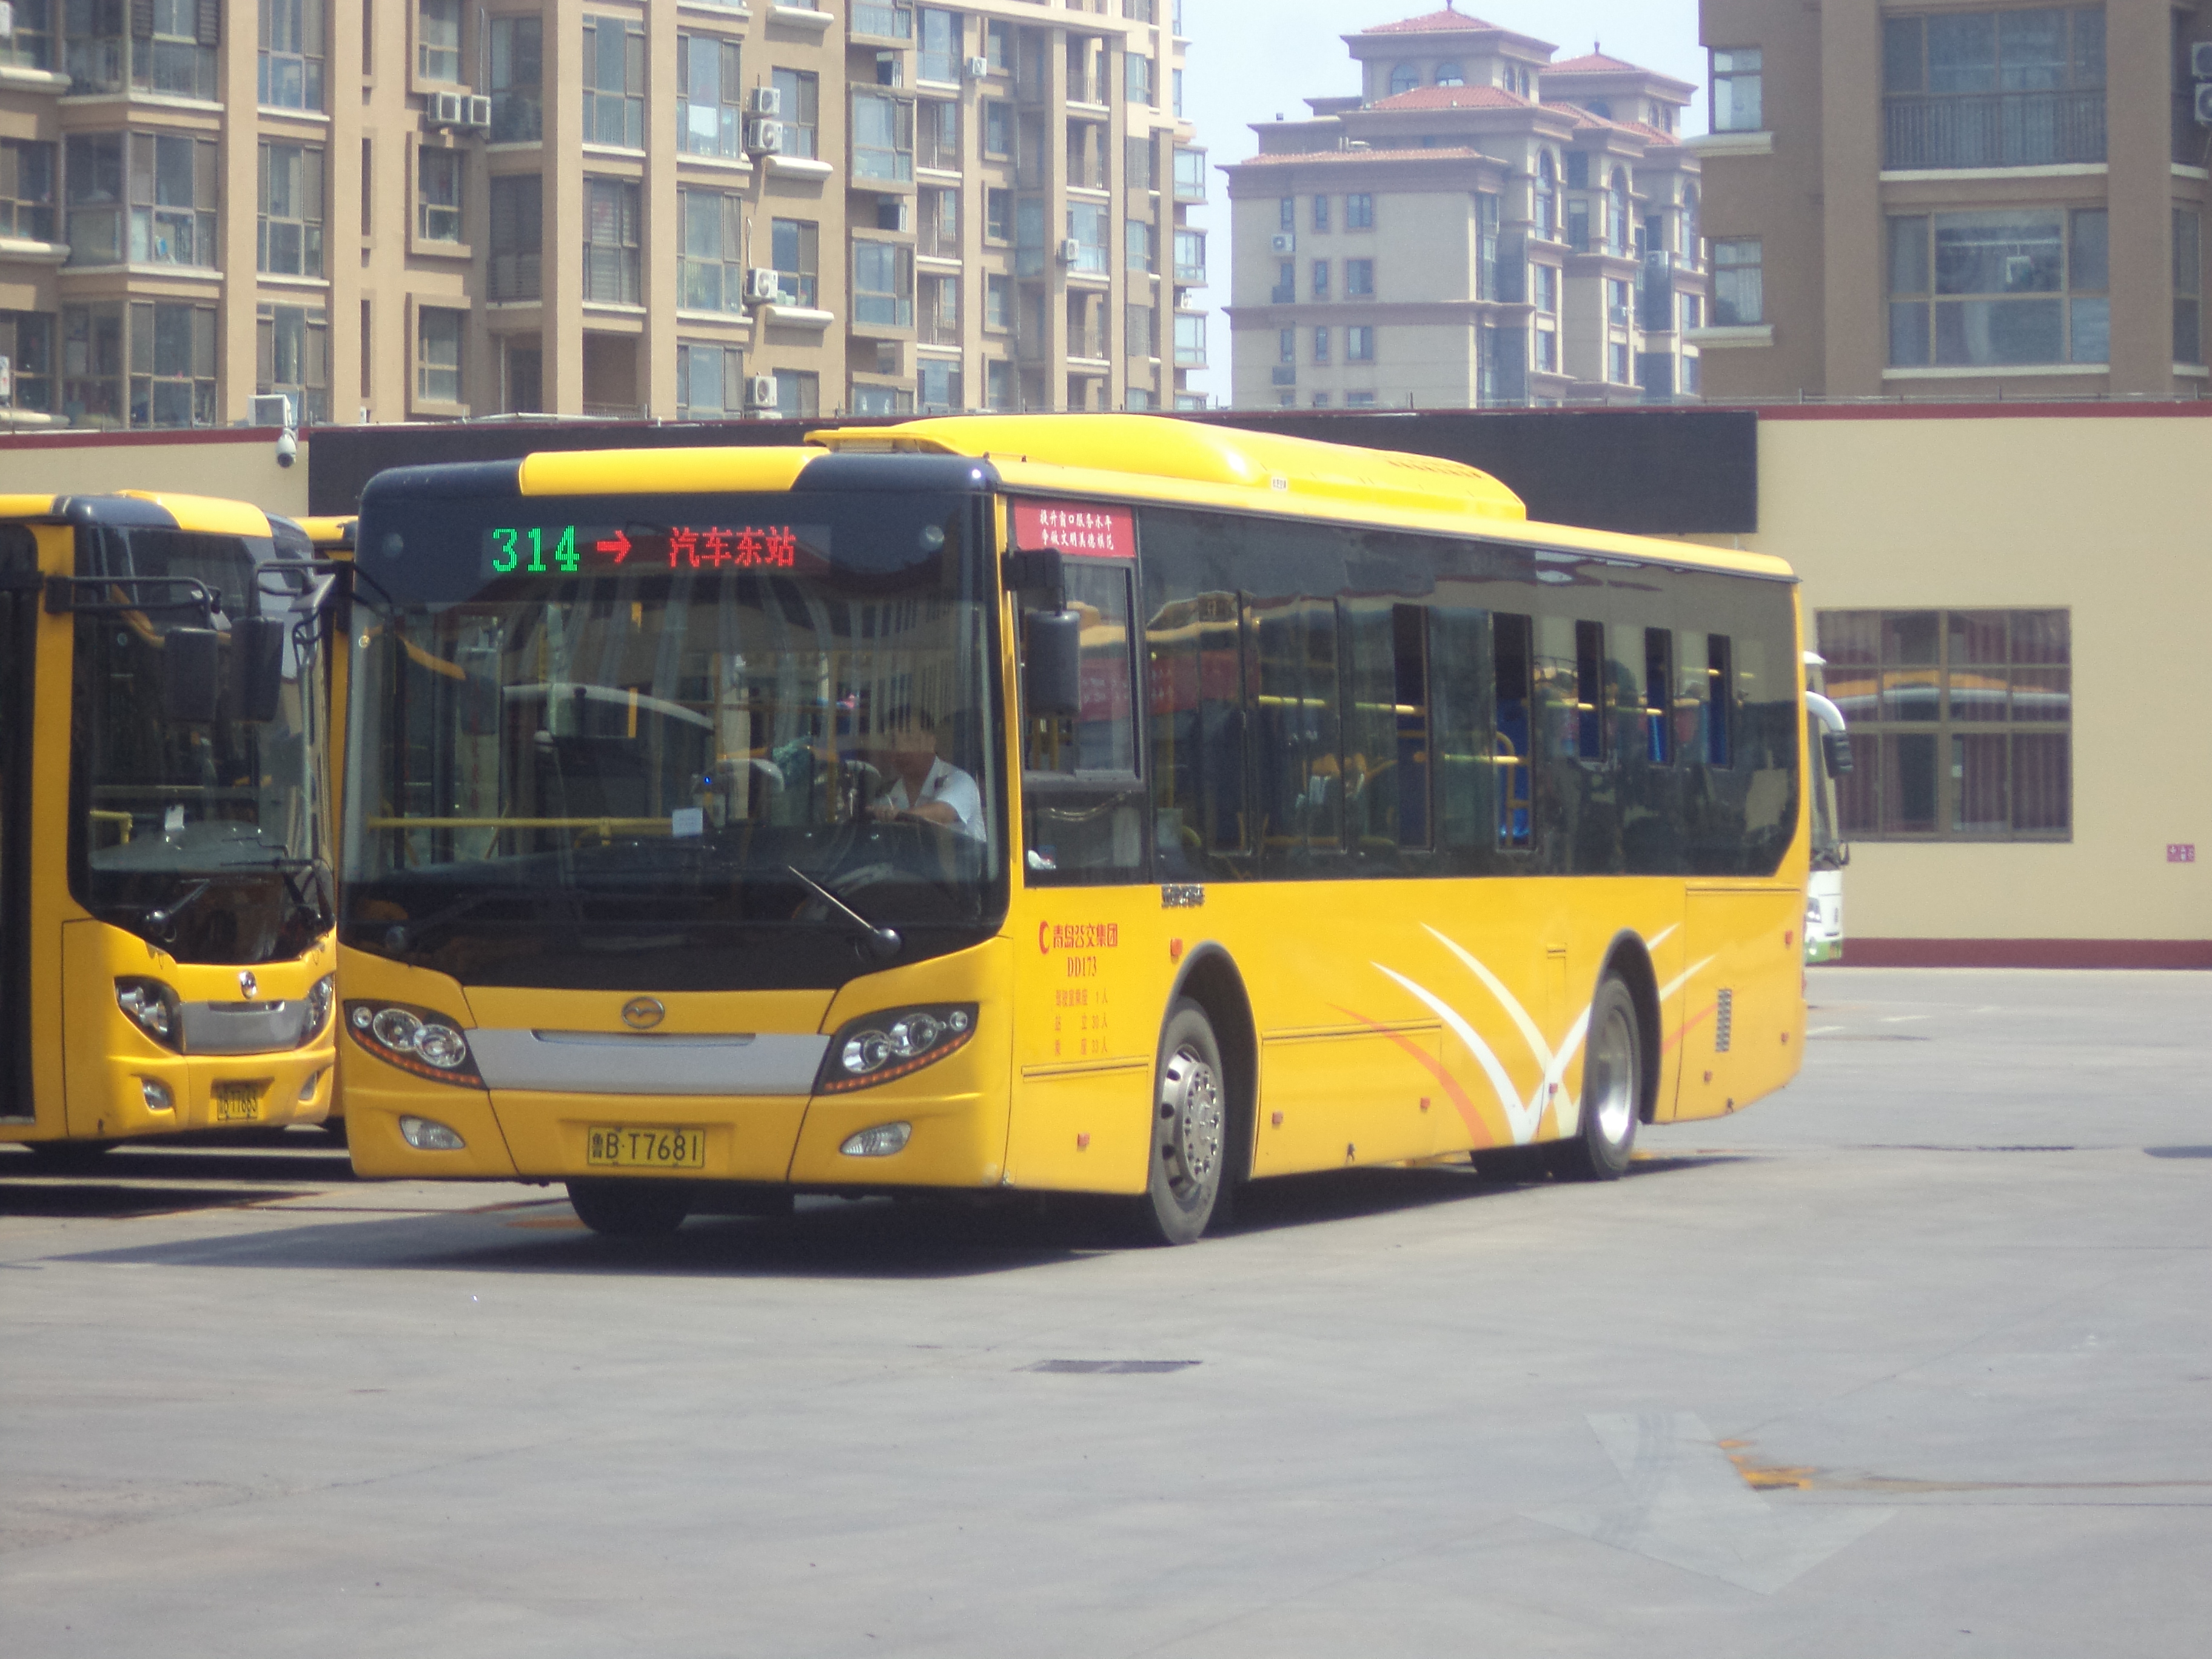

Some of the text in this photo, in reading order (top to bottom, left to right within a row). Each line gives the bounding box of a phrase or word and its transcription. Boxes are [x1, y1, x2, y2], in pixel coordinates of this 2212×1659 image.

[492, 525, 796, 572] 314 汽车东站
[1053, 922, 1118, 948] 青岛公交集团
[1067, 956, 1097, 977] DD173
